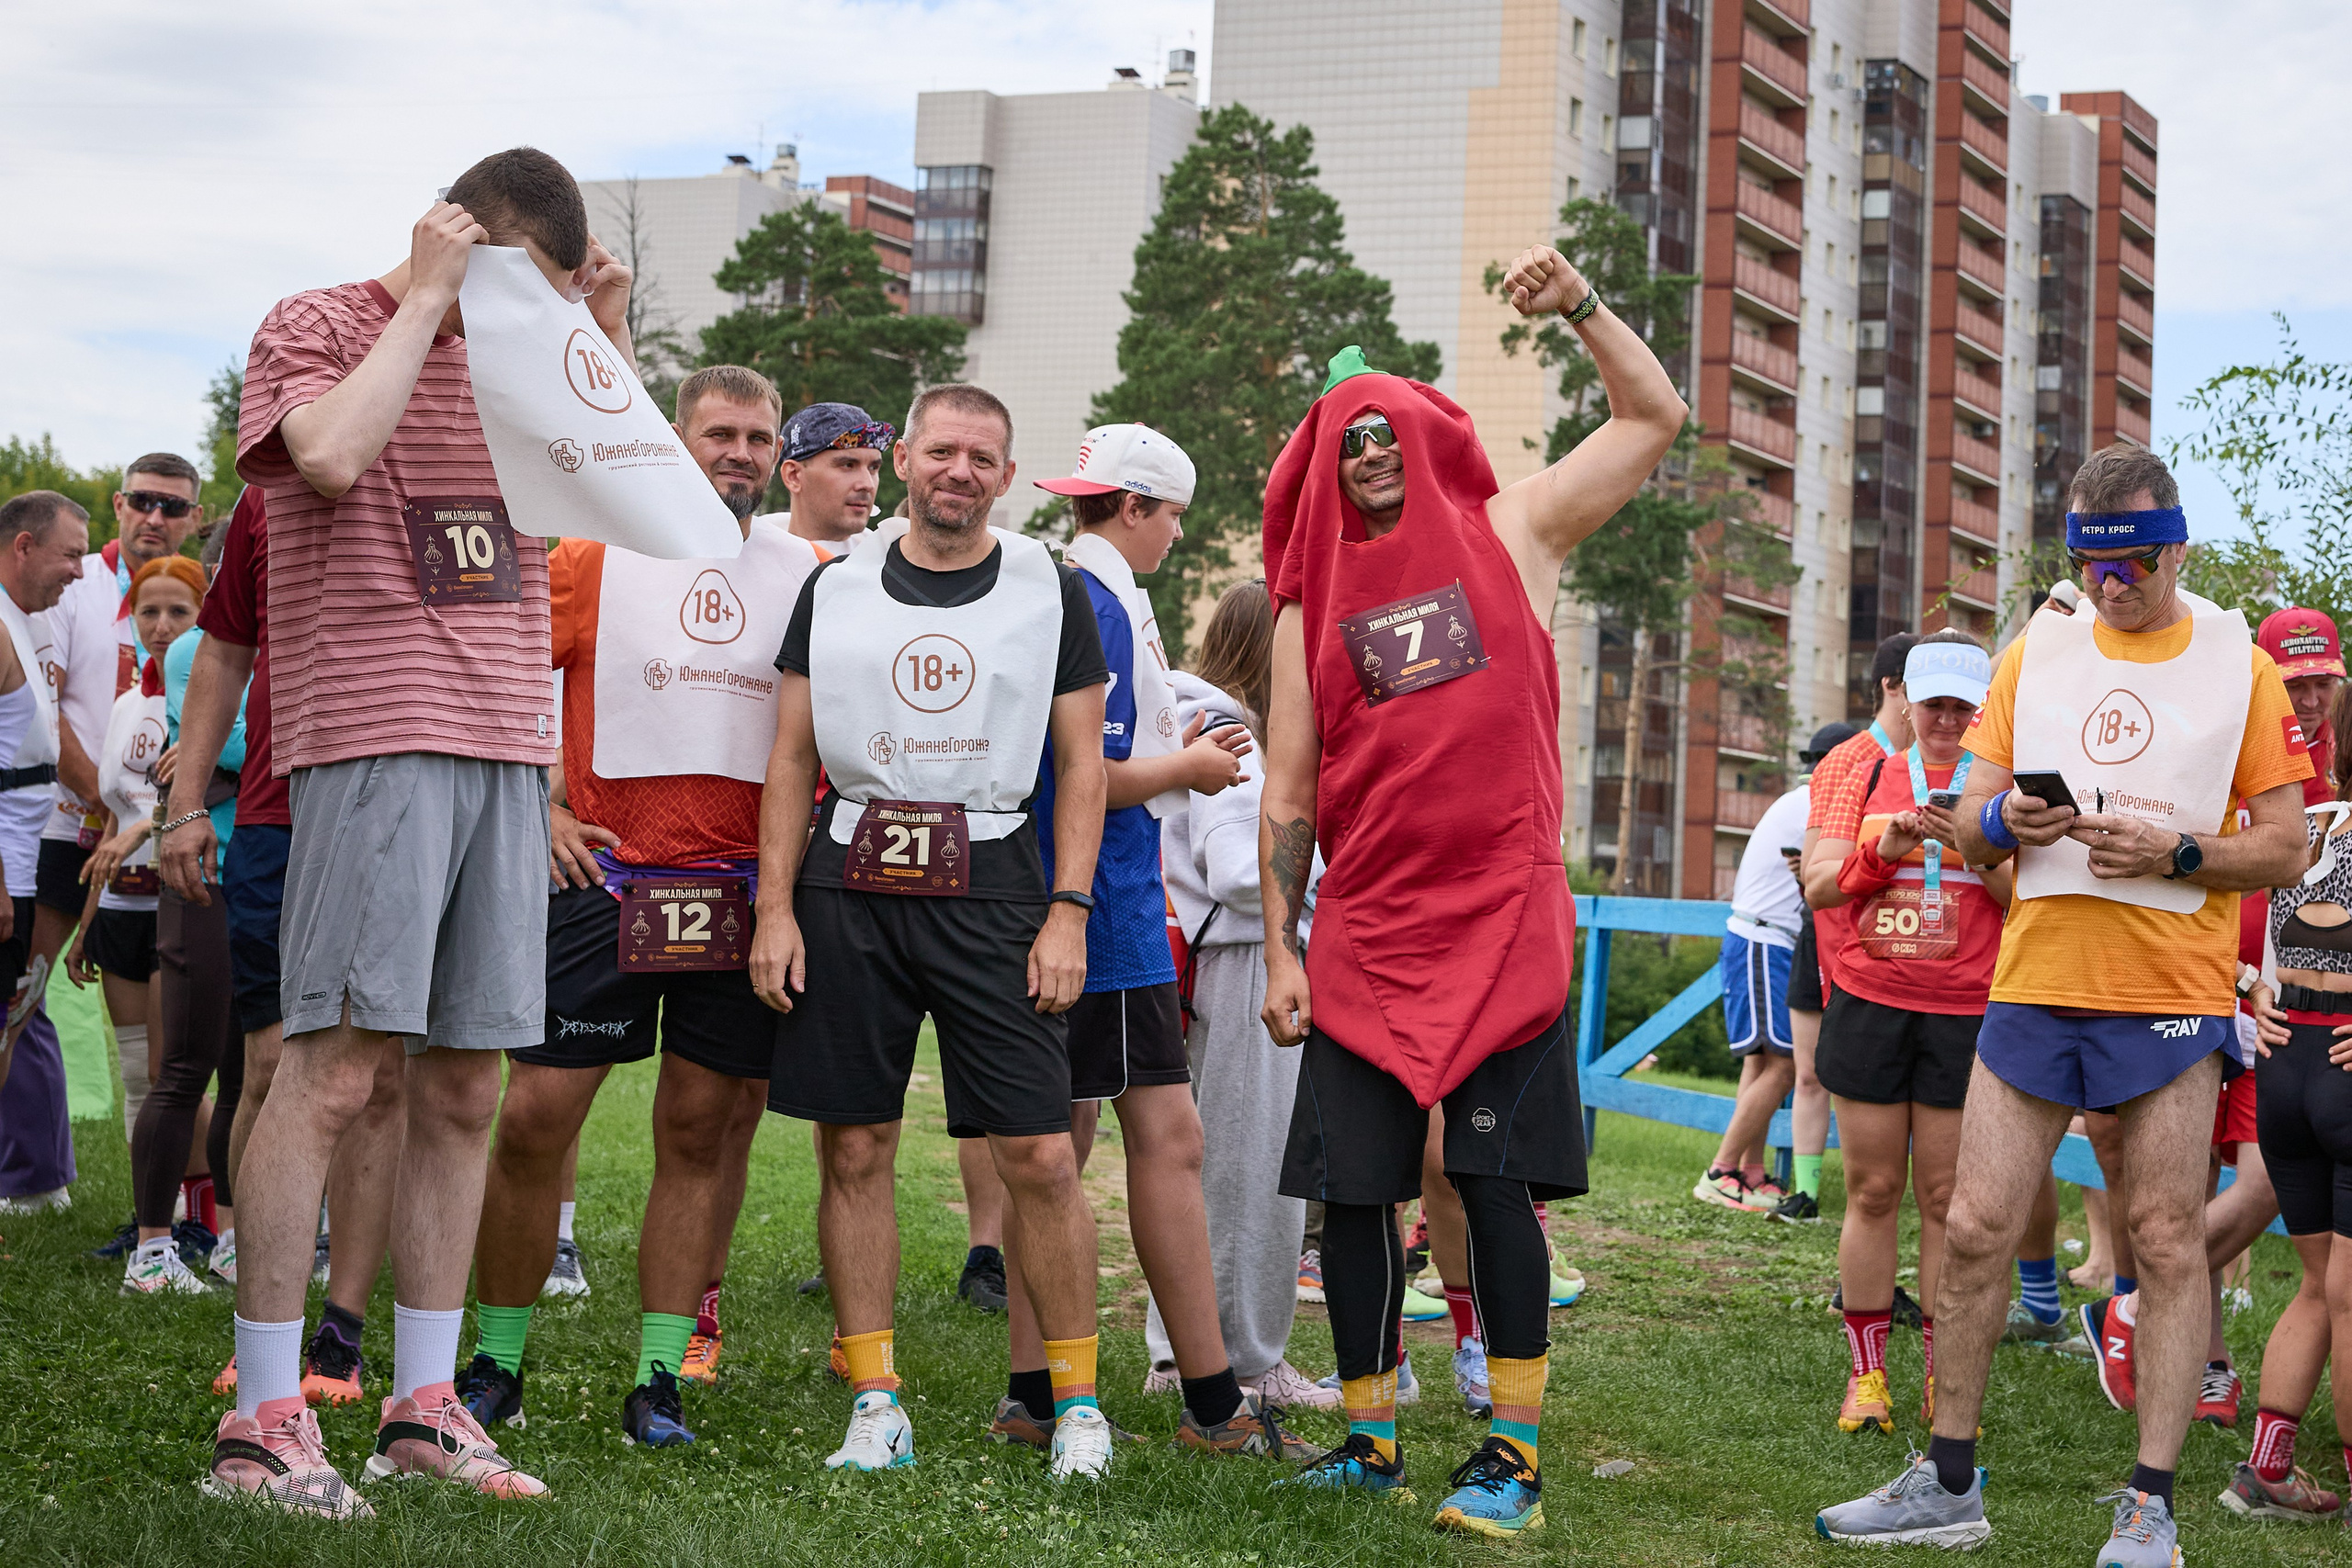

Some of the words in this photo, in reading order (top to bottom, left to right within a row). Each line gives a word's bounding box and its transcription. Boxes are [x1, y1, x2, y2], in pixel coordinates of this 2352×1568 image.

[576, 349, 616, 390] 18+
[1124, 479, 1152, 493] adidas
[434, 510, 477, 522] ХИНКАЛЬНАЯ
[2082, 525, 2105, 534] РЕТРО
[2109, 525, 2135, 534] КРОСС
[445, 525, 494, 569] 10
[695, 589, 734, 624] 18+
[1367, 608, 1419, 632] ХИНКАЛЬНАЯ
[1419, 601, 1440, 616] МИЛЯ
[1394, 620, 1424, 662] 7
[2279, 636, 2329, 649] AERONAUTICA
[2288, 645, 2325, 656] MILITARE
[908, 654, 963, 692] 18+
[1102, 721, 1125, 735] 23
[2097, 709, 2142, 746] 18+
[130, 733, 157, 760] 18+
[877, 809, 921, 823] ХИНКАЛЬНАЯ
[922, 812, 943, 823] МИЛЯ
[880, 824, 931, 865] 21
[650, 888, 701, 899] ХИНКАЛЬНАЯ
[701, 887, 722, 898] МИЛЯ
[661, 901, 712, 941] 12
[1874, 908, 1928, 936] 50
[1892, 942, 1900, 953] 6
[2150, 1017, 2202, 1039] RAY
[2108, 1336, 2126, 1360] N
